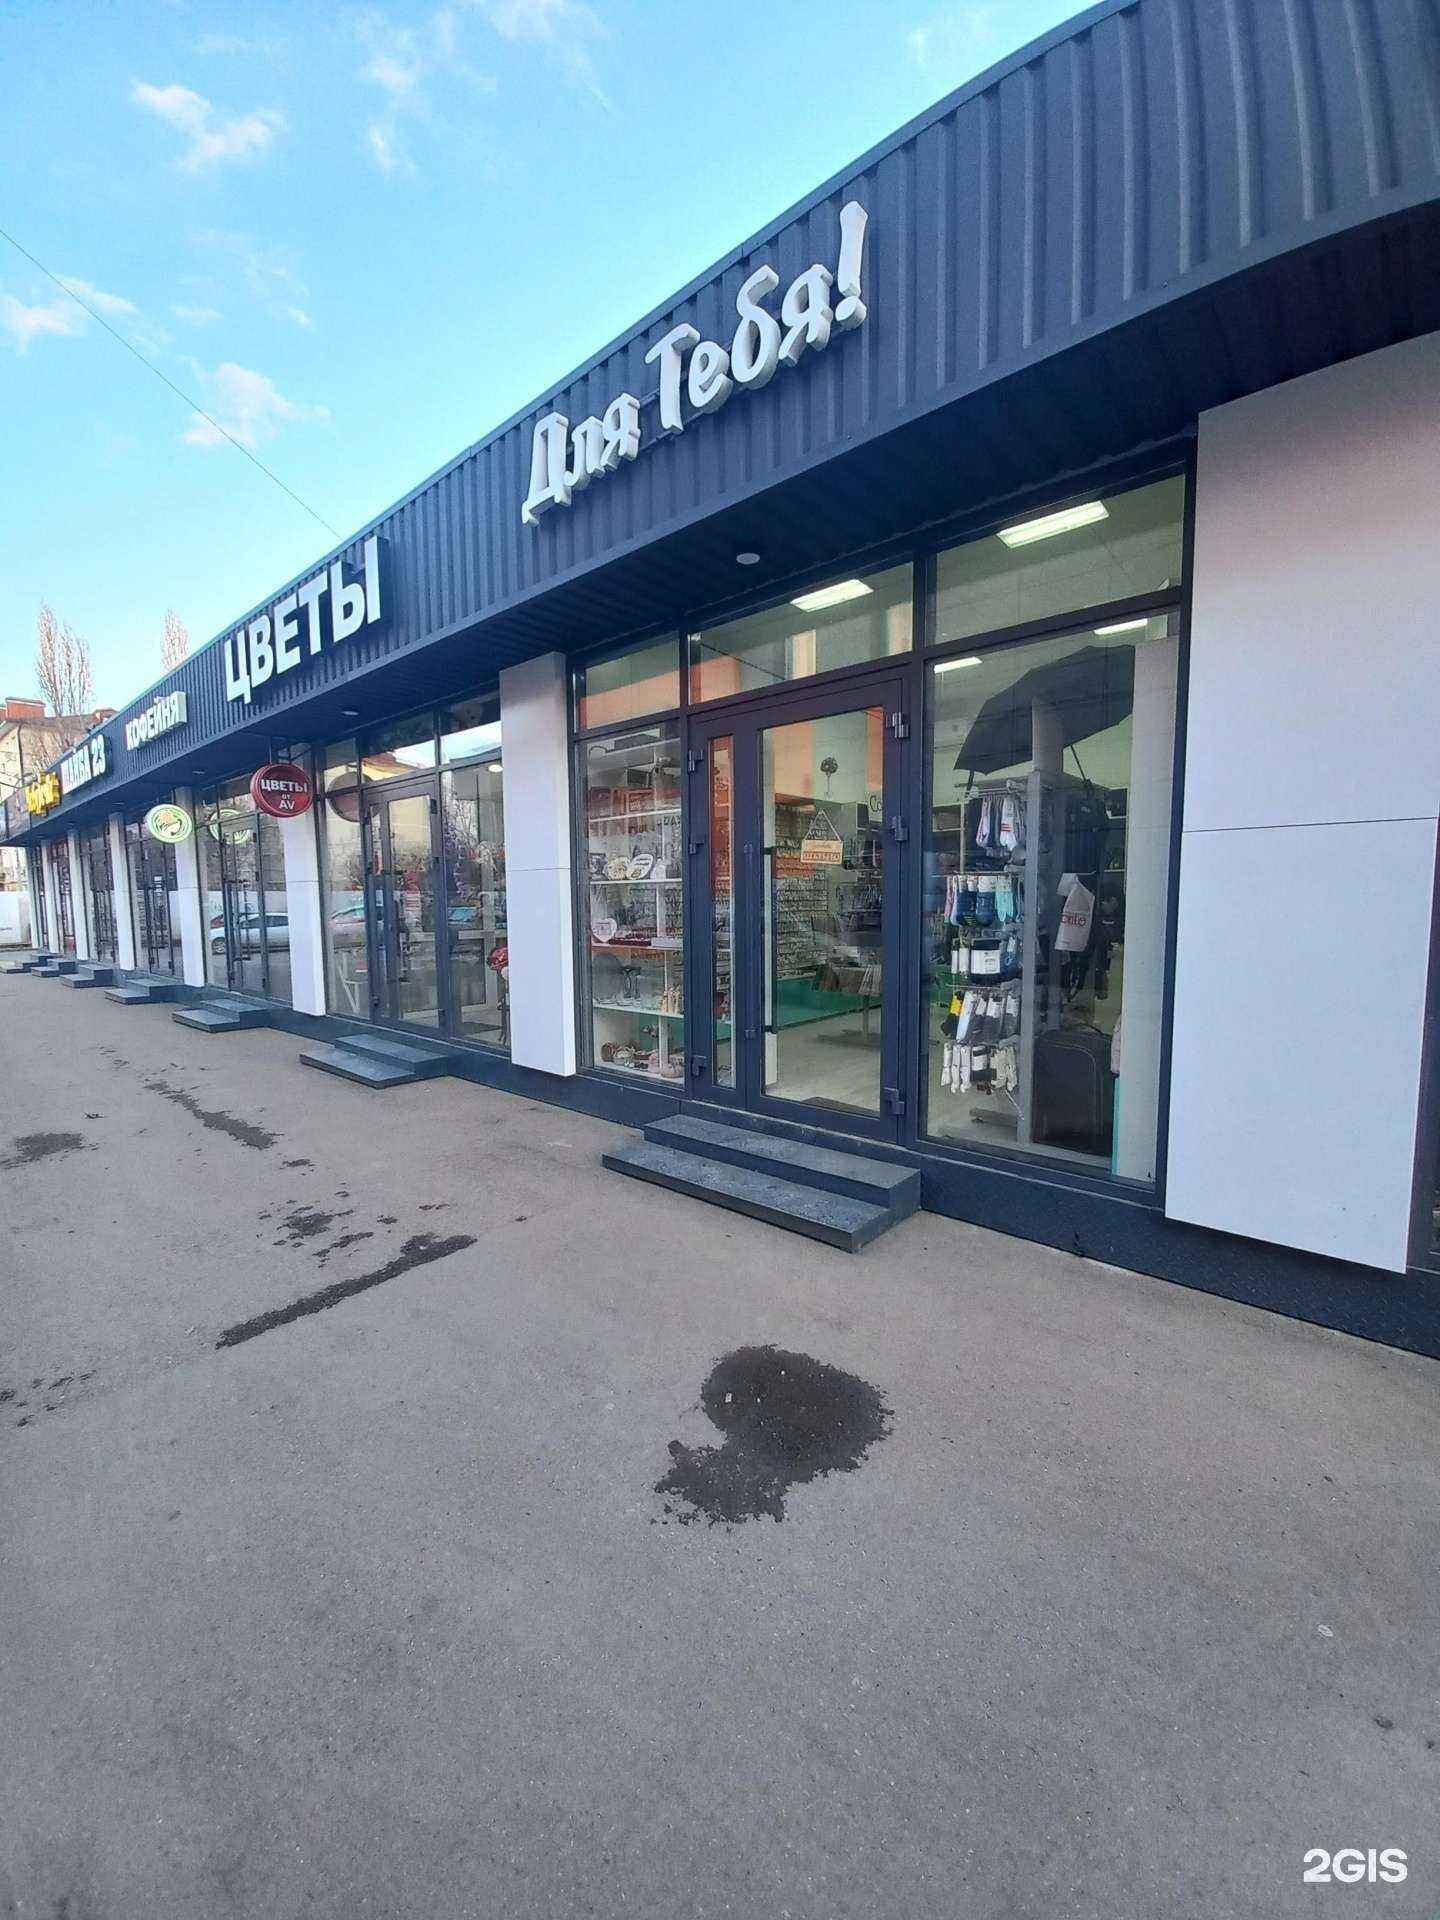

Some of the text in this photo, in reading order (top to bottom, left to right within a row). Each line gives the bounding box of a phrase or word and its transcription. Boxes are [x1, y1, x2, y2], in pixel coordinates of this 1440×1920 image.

[522, 200, 868, 526] Для Тебя!
[224, 535, 381, 704] ЦВЕТЫ
[126, 692, 183, 751] КОФЕЙНЯ
[261, 779, 308, 793] ЦВЕТЫ
[279, 800, 295, 810] AV
